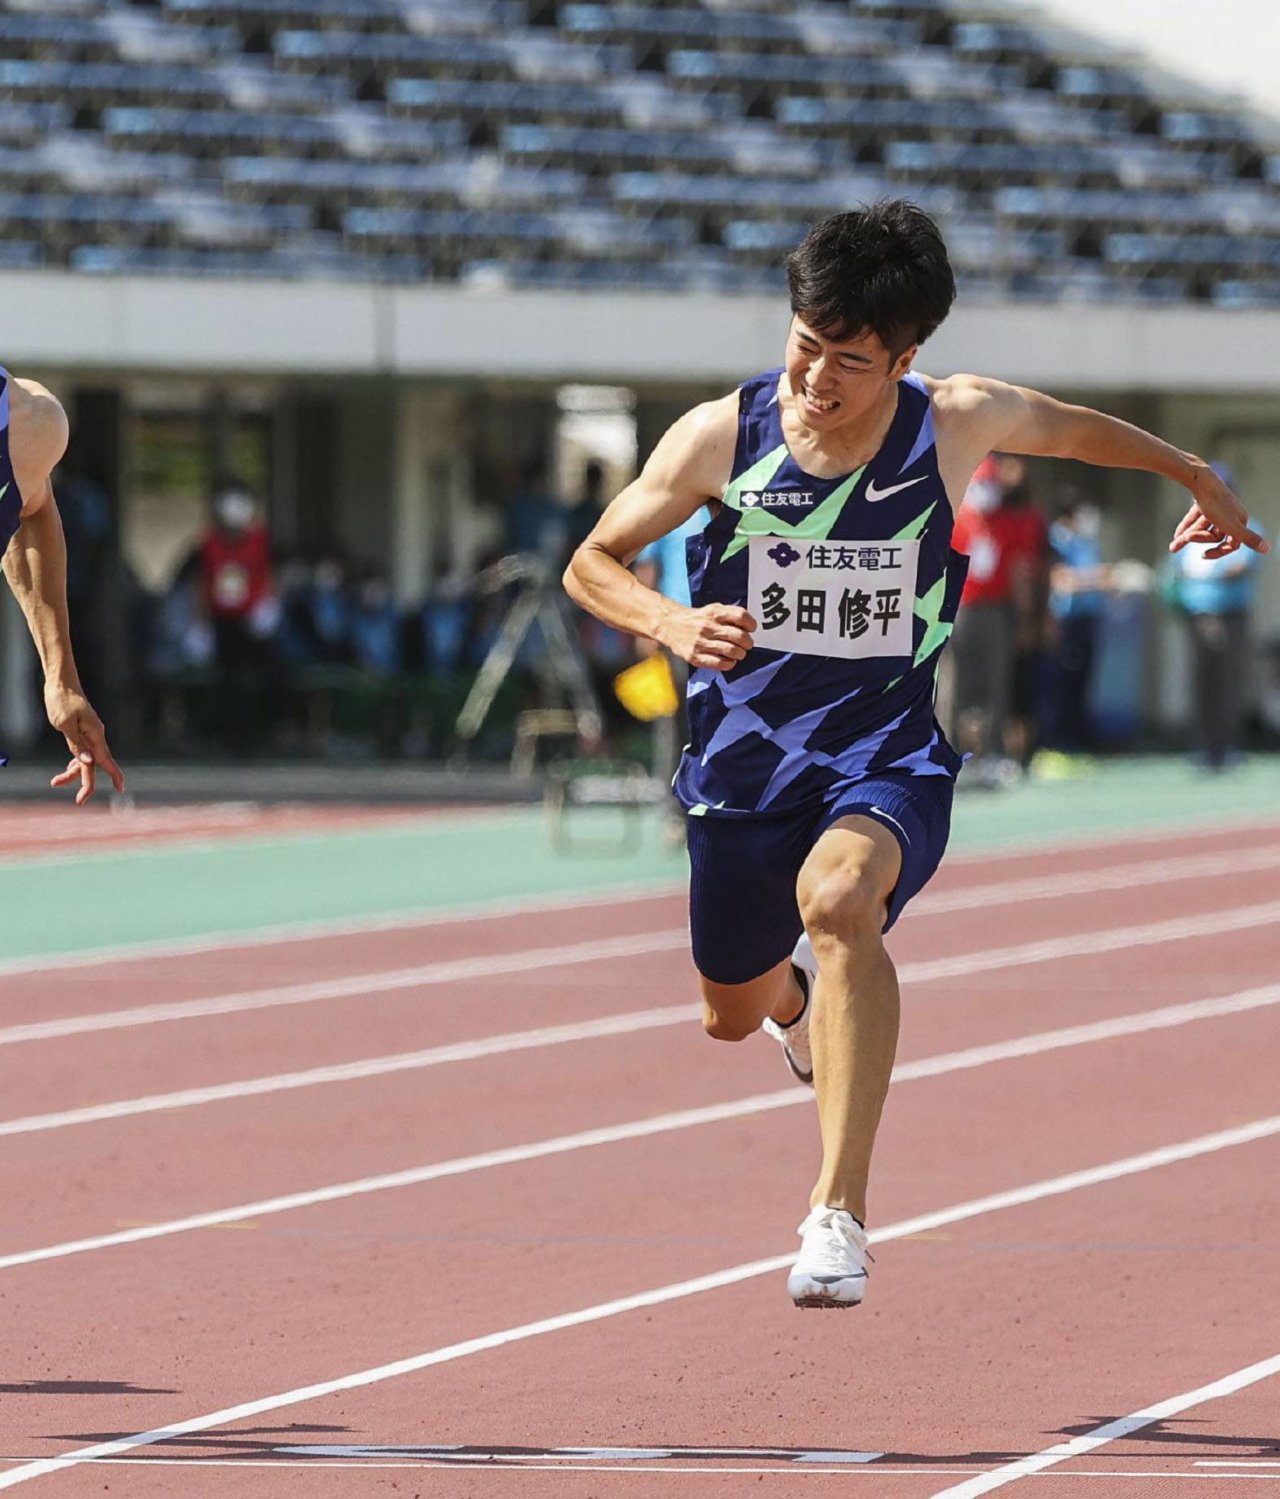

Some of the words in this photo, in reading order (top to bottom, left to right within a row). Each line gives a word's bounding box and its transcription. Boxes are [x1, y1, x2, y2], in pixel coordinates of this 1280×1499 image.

[761, 492, 814, 507] 住友電工
[806, 544, 903, 571] 住友電工
[761, 582, 827, 634] 多田
[837, 587, 902, 640] 修平
